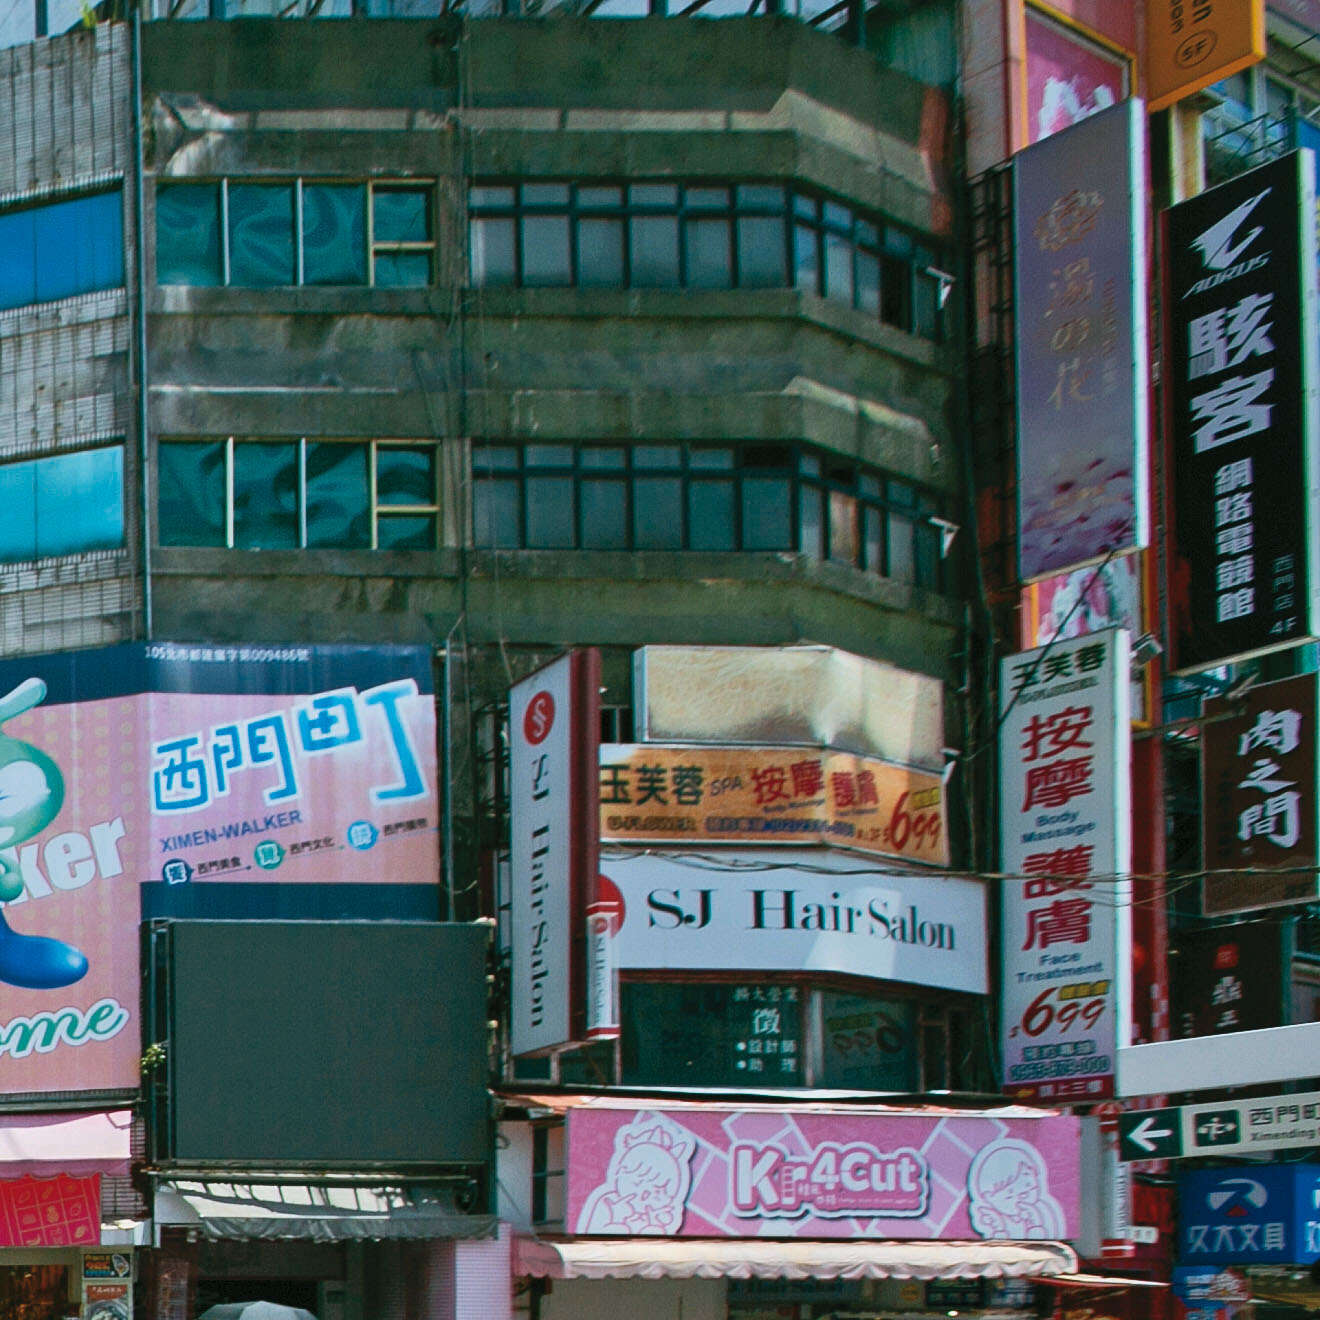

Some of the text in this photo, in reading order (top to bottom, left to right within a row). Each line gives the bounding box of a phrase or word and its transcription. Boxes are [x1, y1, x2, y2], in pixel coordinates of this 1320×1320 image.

[1182, 251, 1272, 299] AORUS
[1188, 292, 1276, 454] 駭客
[1269, 617, 1297, 636] 4F
[151, 678, 429, 816] 西門町
[1020, 704, 1095, 813] 按摩
[710, 775, 745, 798] SPA
[1238, 708, 1303, 848] 肉之間
[161, 809, 303, 853] XIMEN-WALKER
[1020, 820, 1098, 844] Massage
[1036, 809, 1080, 828] Body
[530, 824, 551, 916] Hair
[646, 887, 957, 951] SJ Hair Salon
[1020, 843, 1095, 951] 護膚
[530, 918, 551, 1028] Salon
[1015, 961, 1105, 984] Treatment
[1039, 951, 1082, 967] Face
[1249, 1127, 1317, 1142] Ximending
